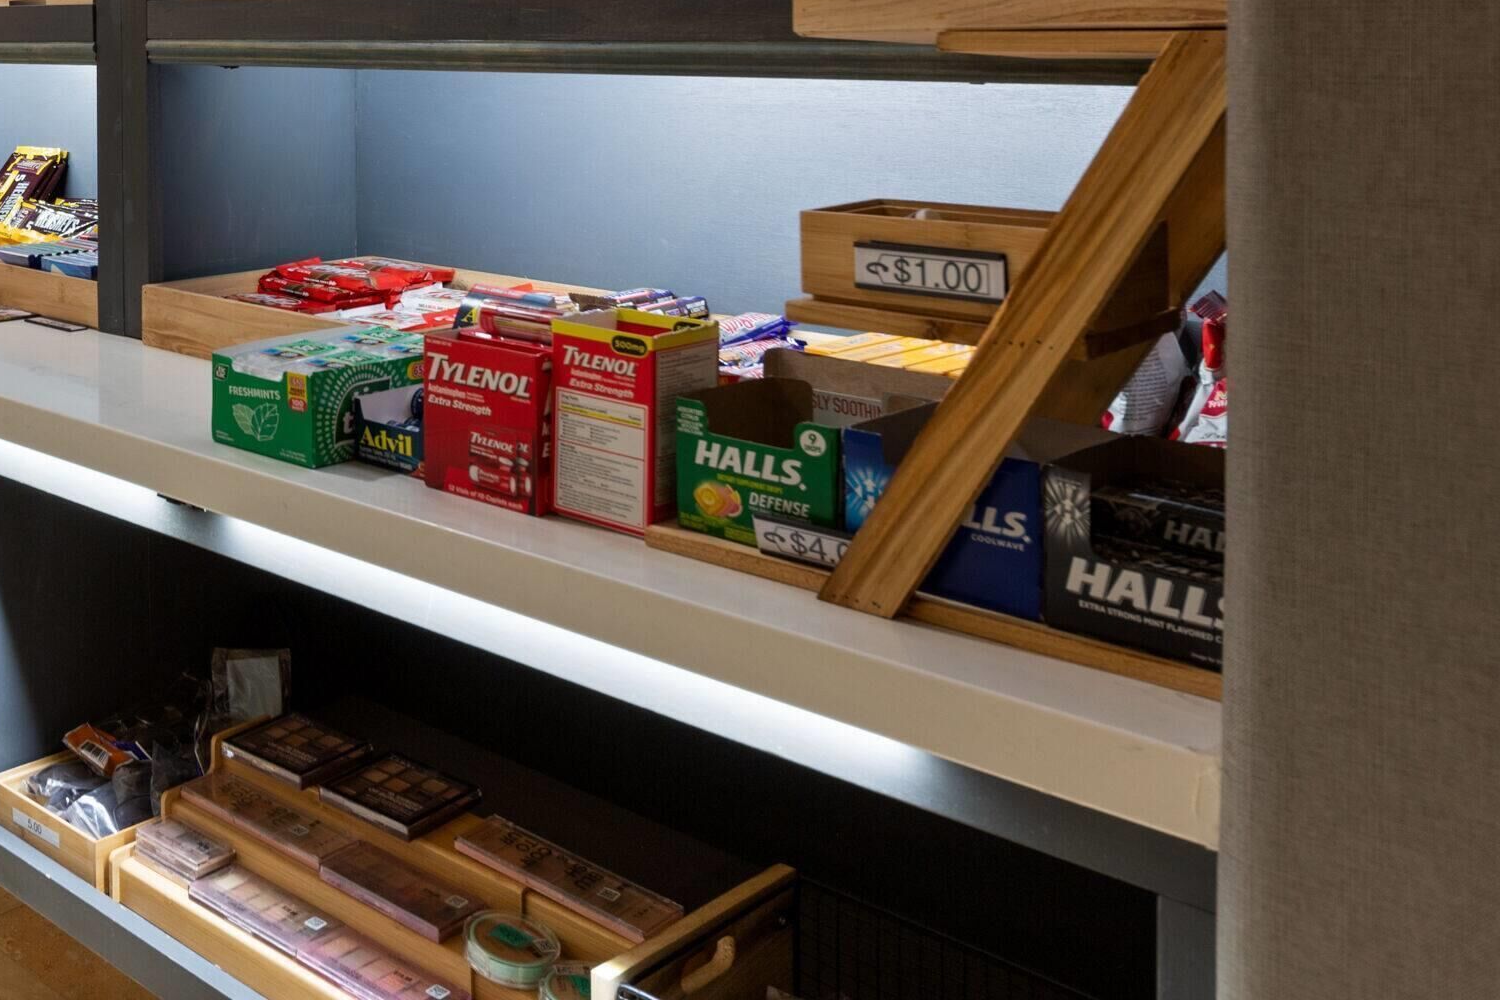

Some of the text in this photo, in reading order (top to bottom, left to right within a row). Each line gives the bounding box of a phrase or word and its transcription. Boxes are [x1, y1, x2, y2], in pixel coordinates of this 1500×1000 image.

[894, 256, 982, 293] $1.00
[563, 345, 638, 377] TYLENOL
[427, 352, 531, 398] TYLENOL
[229, 386, 281, 400] FRESHMINTS
[569, 378, 635, 399] Extra Strength
[428, 395, 492, 416] Extra Strength
[360, 425, 412, 456] Advil
[470, 432, 514, 453] TYLENOL
[808, 433, 817, 445] 9
[695, 441, 802, 485] HALLS
[749, 492, 810, 517] DEFENSE
[971, 533, 1025, 551] COOLWAVE
[1078, 600, 1212, 642] EXTRA STRONG MINT FLAVORED
[27, 818, 42, 835] 5.00
